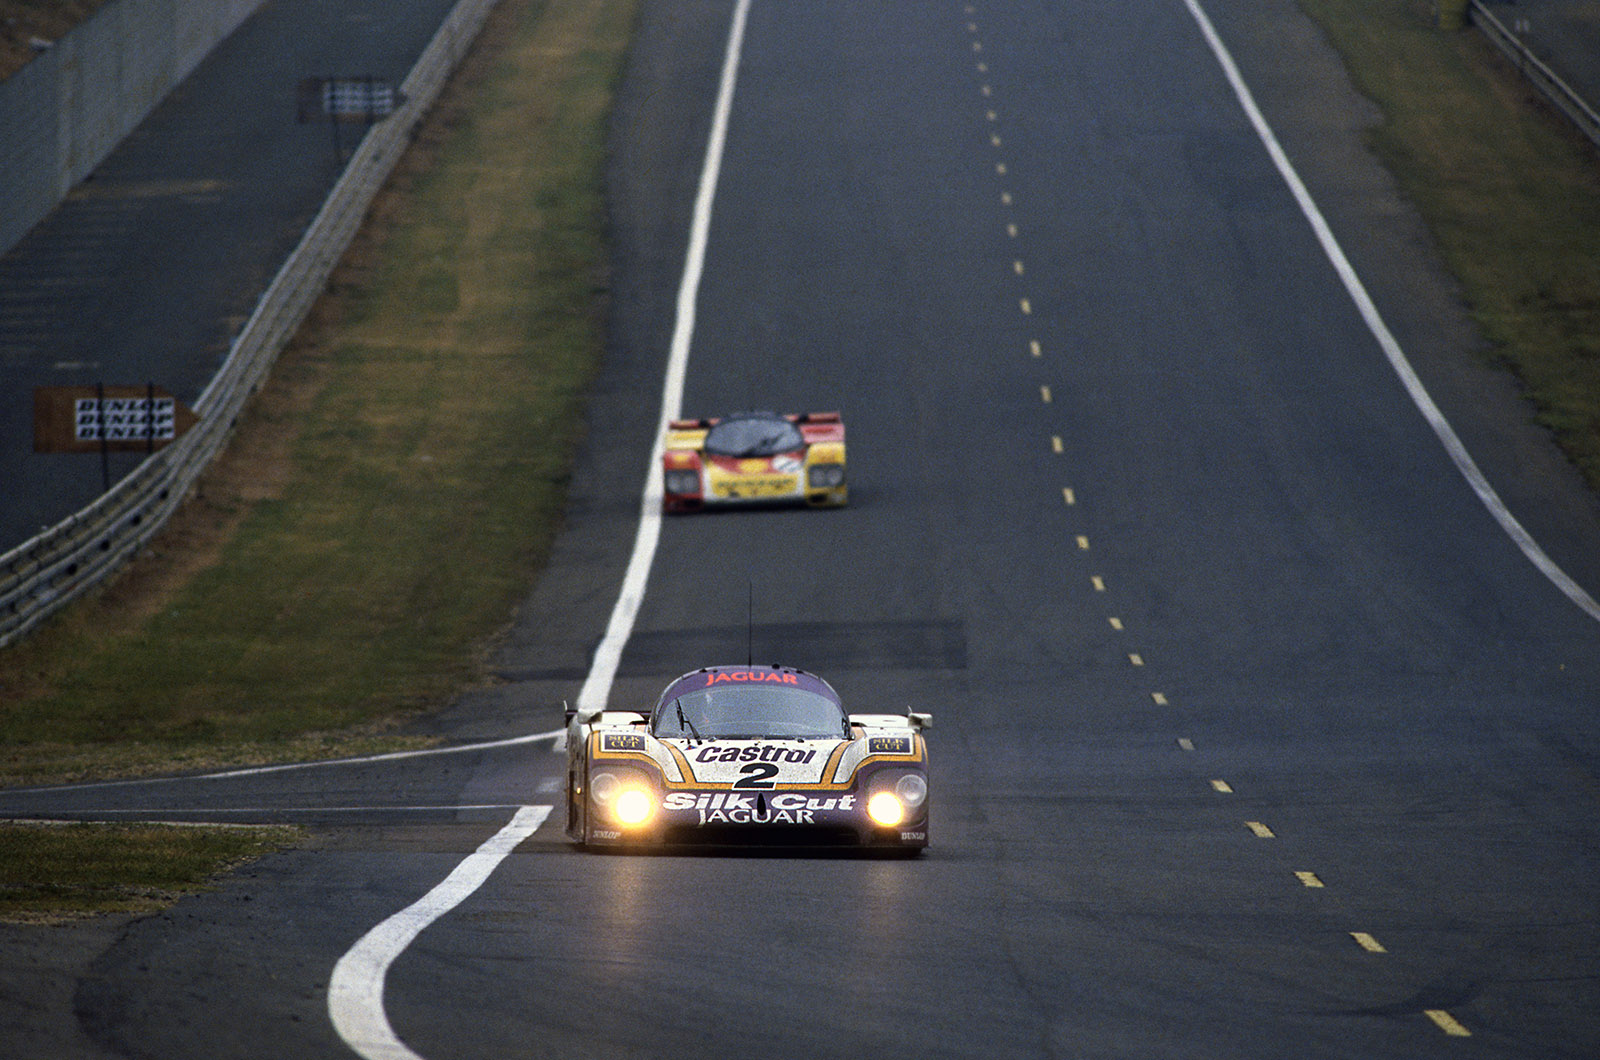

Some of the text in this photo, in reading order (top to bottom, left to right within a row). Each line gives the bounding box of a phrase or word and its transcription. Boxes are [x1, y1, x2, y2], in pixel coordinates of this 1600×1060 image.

[705, 671, 799, 686] JAGUAR
[611, 740, 639, 748] CUT
[695, 744, 817, 764] Castrol
[732, 762, 780, 789] 2
[662, 792, 857, 811] Silk Cut
[696, 808, 816, 828] JAGUAR
